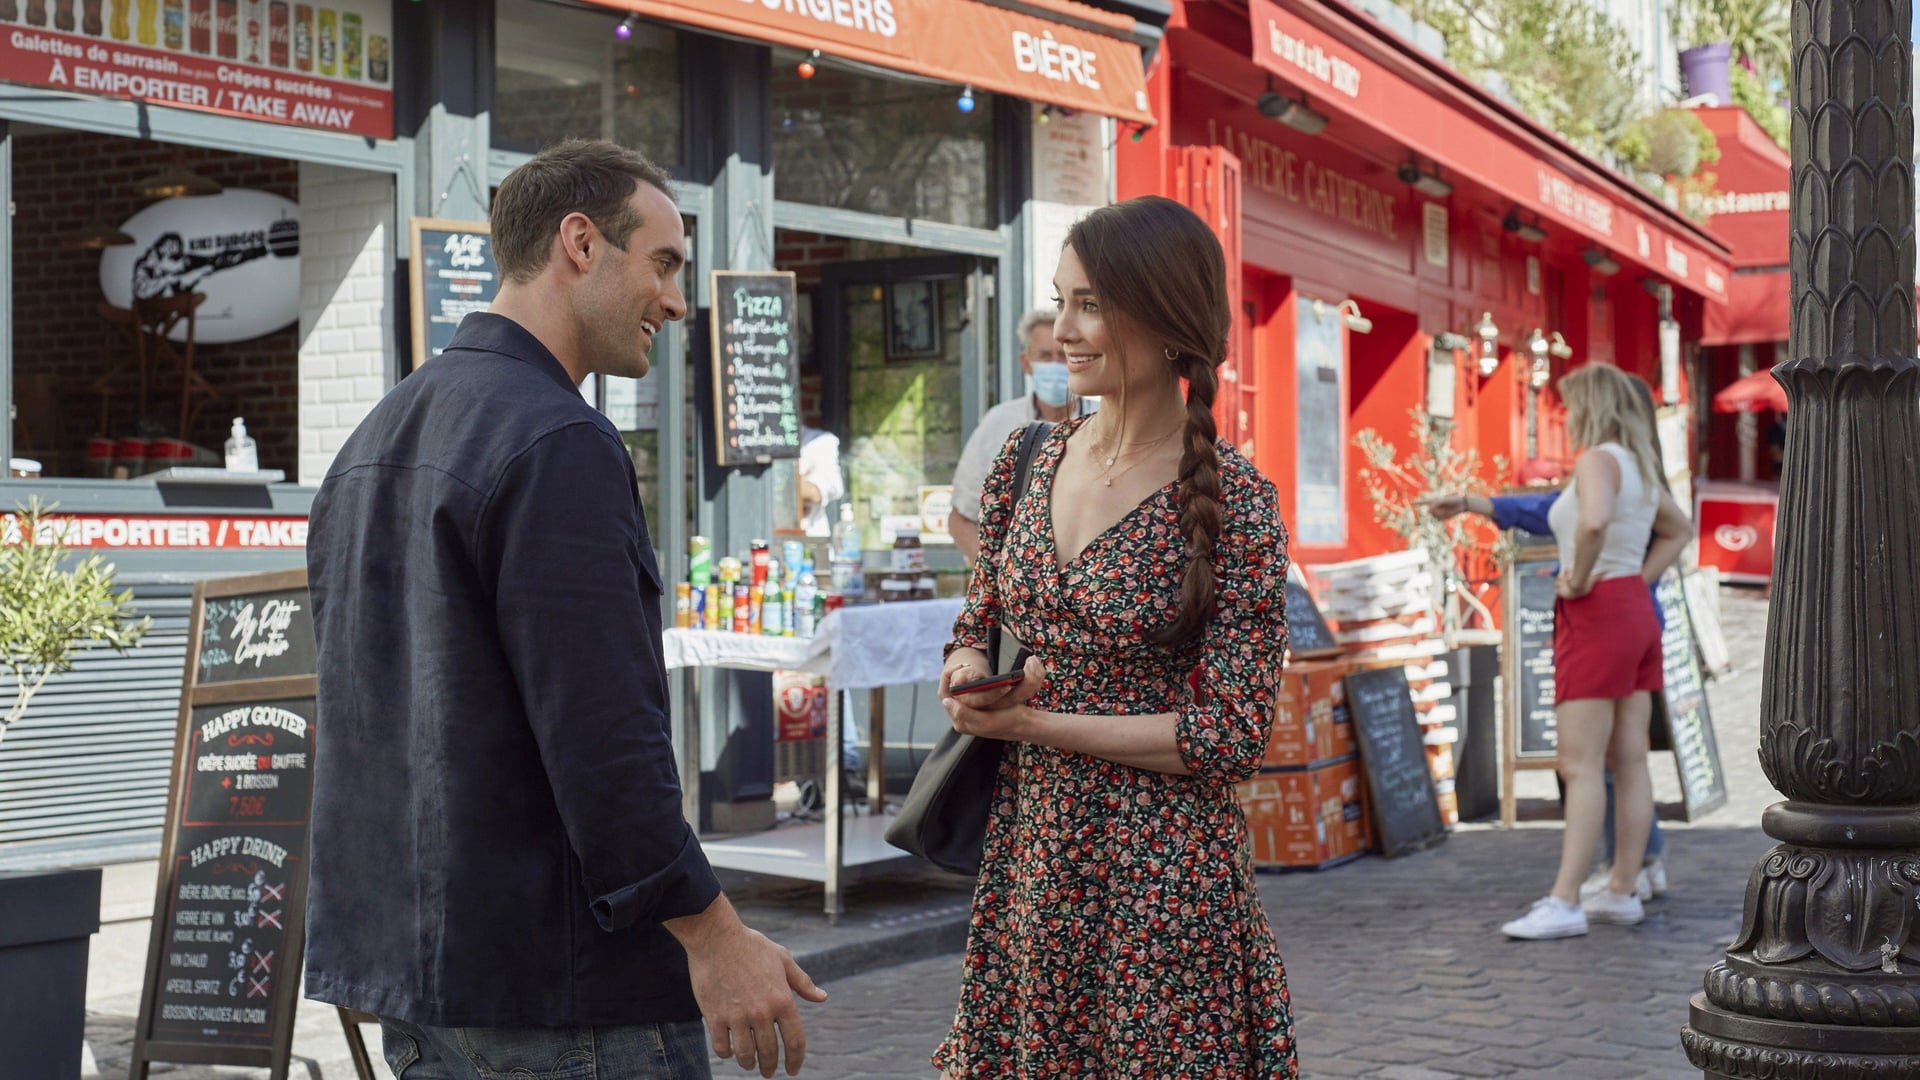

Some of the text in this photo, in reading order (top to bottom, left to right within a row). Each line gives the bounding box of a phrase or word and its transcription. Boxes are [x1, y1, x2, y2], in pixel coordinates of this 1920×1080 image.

[11, 32, 83, 58] Galettes
[87, 46, 109, 62] de
[112, 52, 178, 73] sarrasin
[217, 66, 272, 88] Crêpes
[274, 78, 332, 100] sucrées
[1012, 29, 1101, 90] BIÈRE
[49, 58, 68, 85] À
[74, 66, 209, 105] EMPORTER
[214, 88, 224, 108] /
[228, 91, 287, 118] TAKE
[292, 102, 353, 129] AWAY
[1304, 160, 1397, 240] CATHERINE
[1687, 190, 1790, 215] Restaura
[34, 518, 209, 547] EMPORTER
[216, 520, 228, 547] /
[234, 520, 308, 547] TAKE
[201, 707, 252, 742] HAPPY
[242, 773, 279, 790] BOISSON
[190, 836, 288, 868] HAPPY DRINK
[182, 953, 208, 968] CHAUD
[166, 979, 193, 994] APEROL
[194, 980, 220, 995] SPRITZ
[162, 1004, 198, 1021] BOISSONS
[198, 1006, 232, 1022] CHAUDES
[243, 1008, 266, 1024] CHOIX
